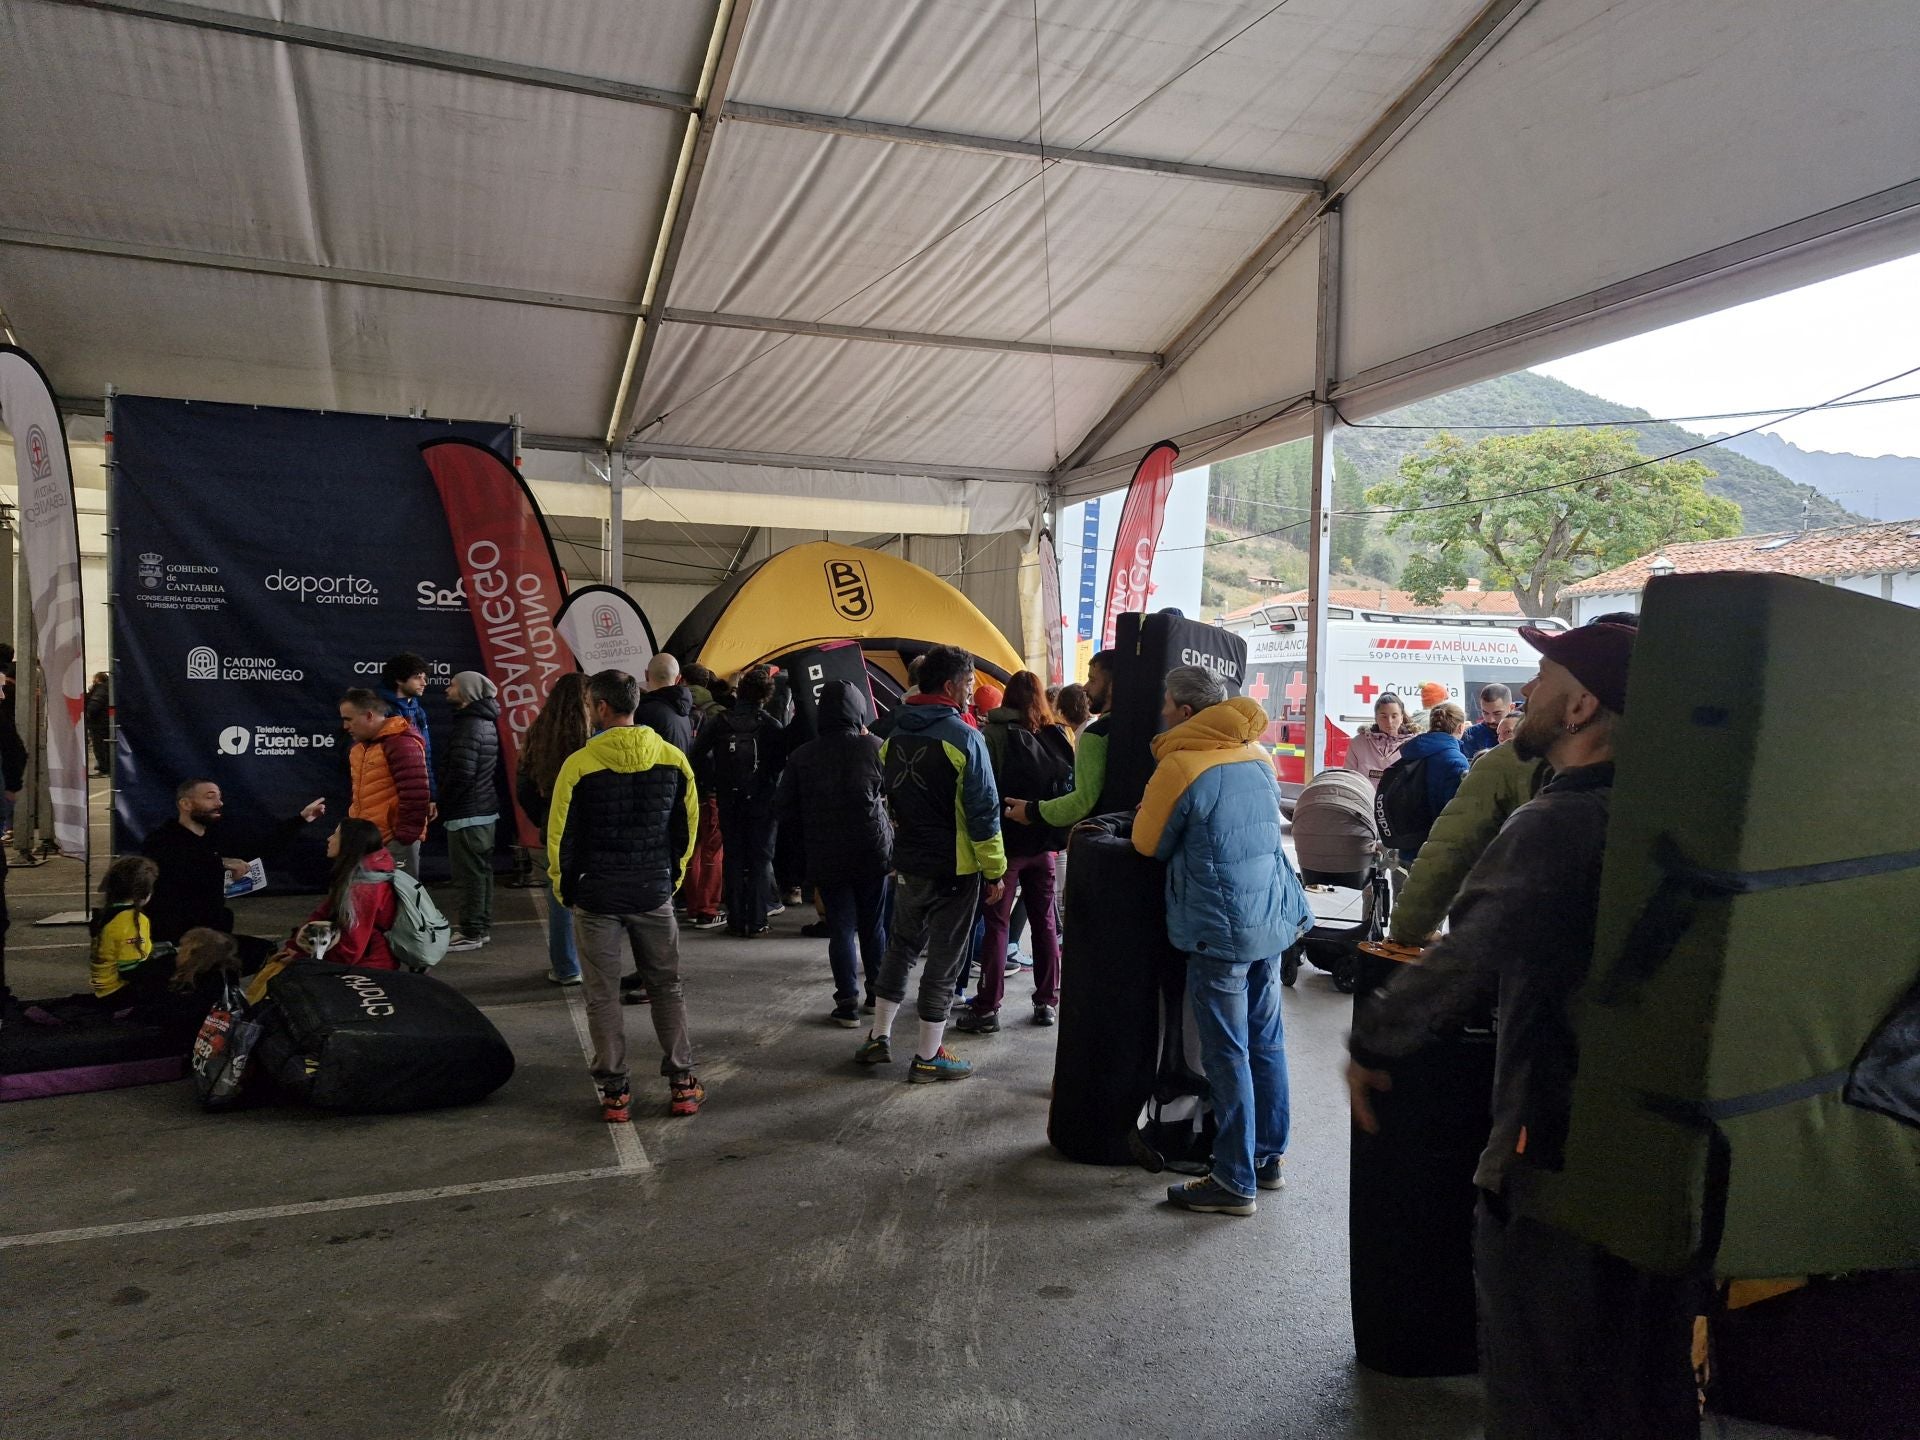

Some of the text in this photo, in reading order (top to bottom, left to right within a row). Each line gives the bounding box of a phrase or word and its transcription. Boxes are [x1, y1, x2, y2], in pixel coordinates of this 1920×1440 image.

[166, 564, 219, 574] GOBIERNO
[166, 574, 177, 582] de
[166, 582, 226, 593] CANTABRIA
[315, 593, 379, 605] cantabria
[145, 602, 179, 610] TURISMO
[185, 603, 219, 611] DEPORTE
[1433, 640, 1519, 654] AMBULANCIA
[223, 656, 276, 668] CAMINO
[1181, 648, 1238, 678] EDELRID
[1369, 651, 1519, 665] SOPORTE VITAL AVANZADO
[223, 668, 304, 681] LEBANIEGO
[255, 725, 296, 734] Teleférico
[254, 734, 335, 748] Fuente Dé
[254, 747, 295, 756] Cantabria
[1376, 793, 1392, 838] adidas
